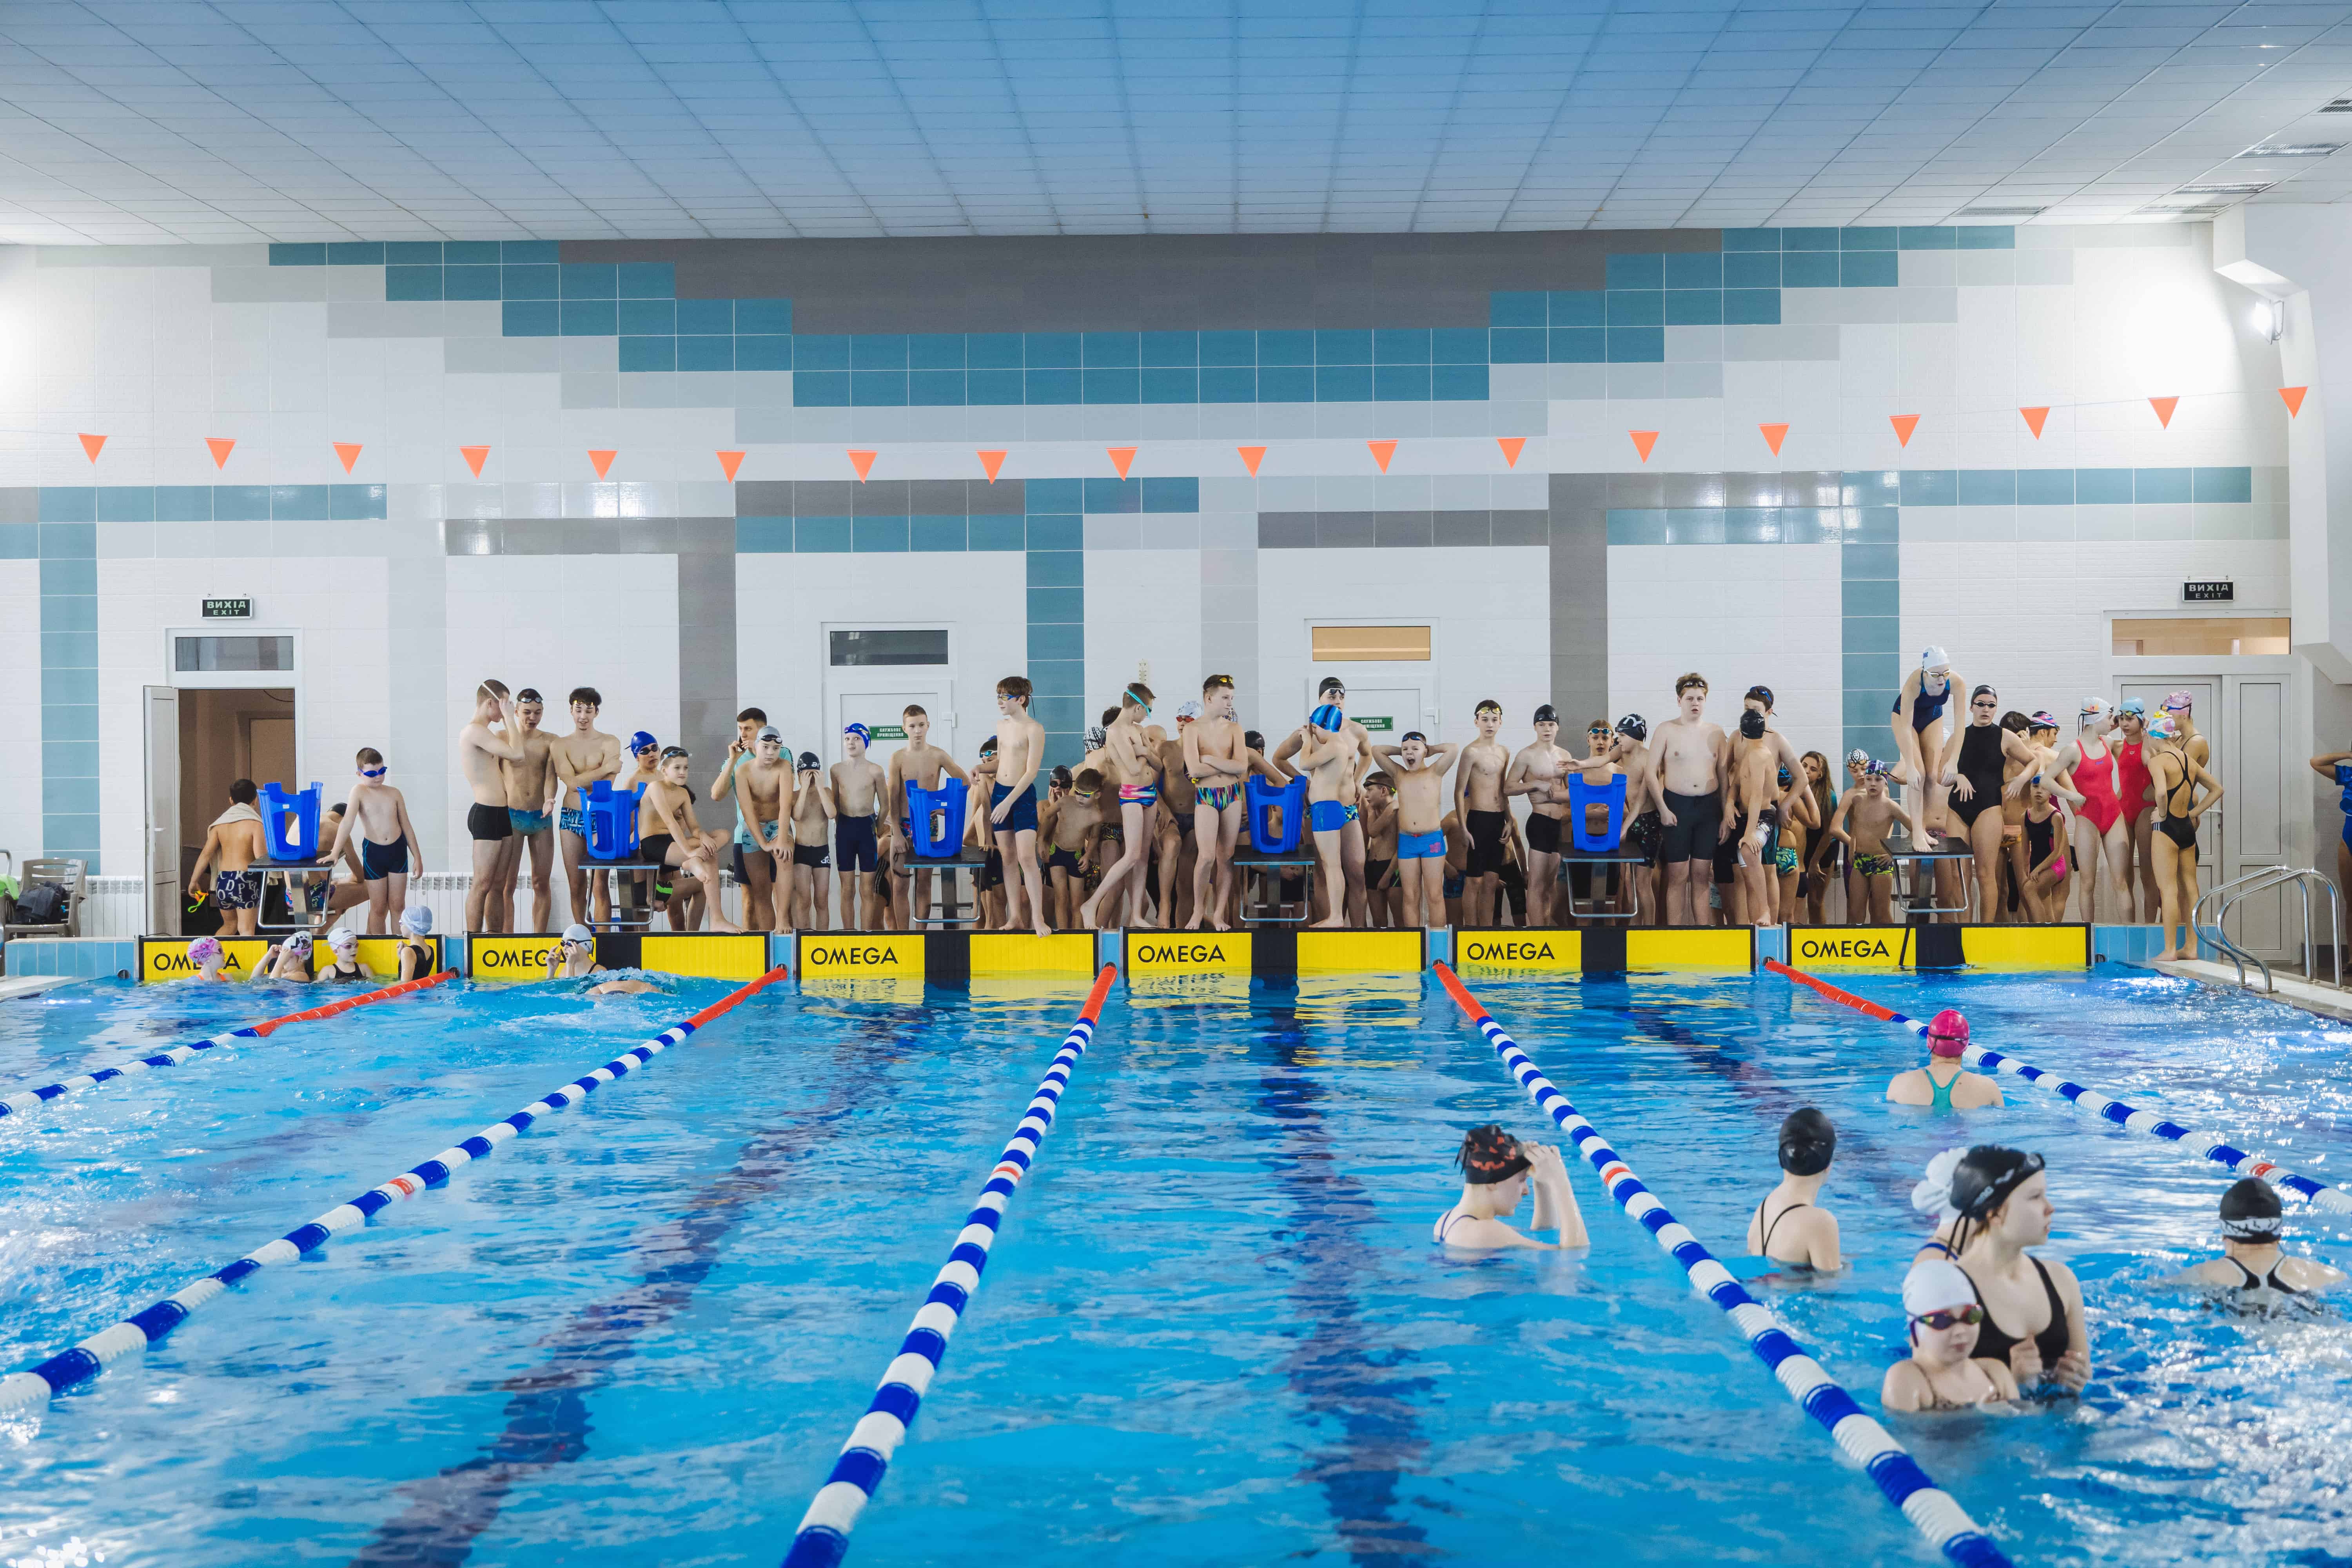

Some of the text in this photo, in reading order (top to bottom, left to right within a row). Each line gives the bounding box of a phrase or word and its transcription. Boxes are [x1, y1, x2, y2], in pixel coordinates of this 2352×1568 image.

[811, 947, 898, 965] OMEGA
[1138, 944, 1226, 963] OMEGA
[1467, 942, 1555, 960] OMEGA
[1802, 939, 1890, 958] OMEGA
[154, 952, 241, 971] OMA
